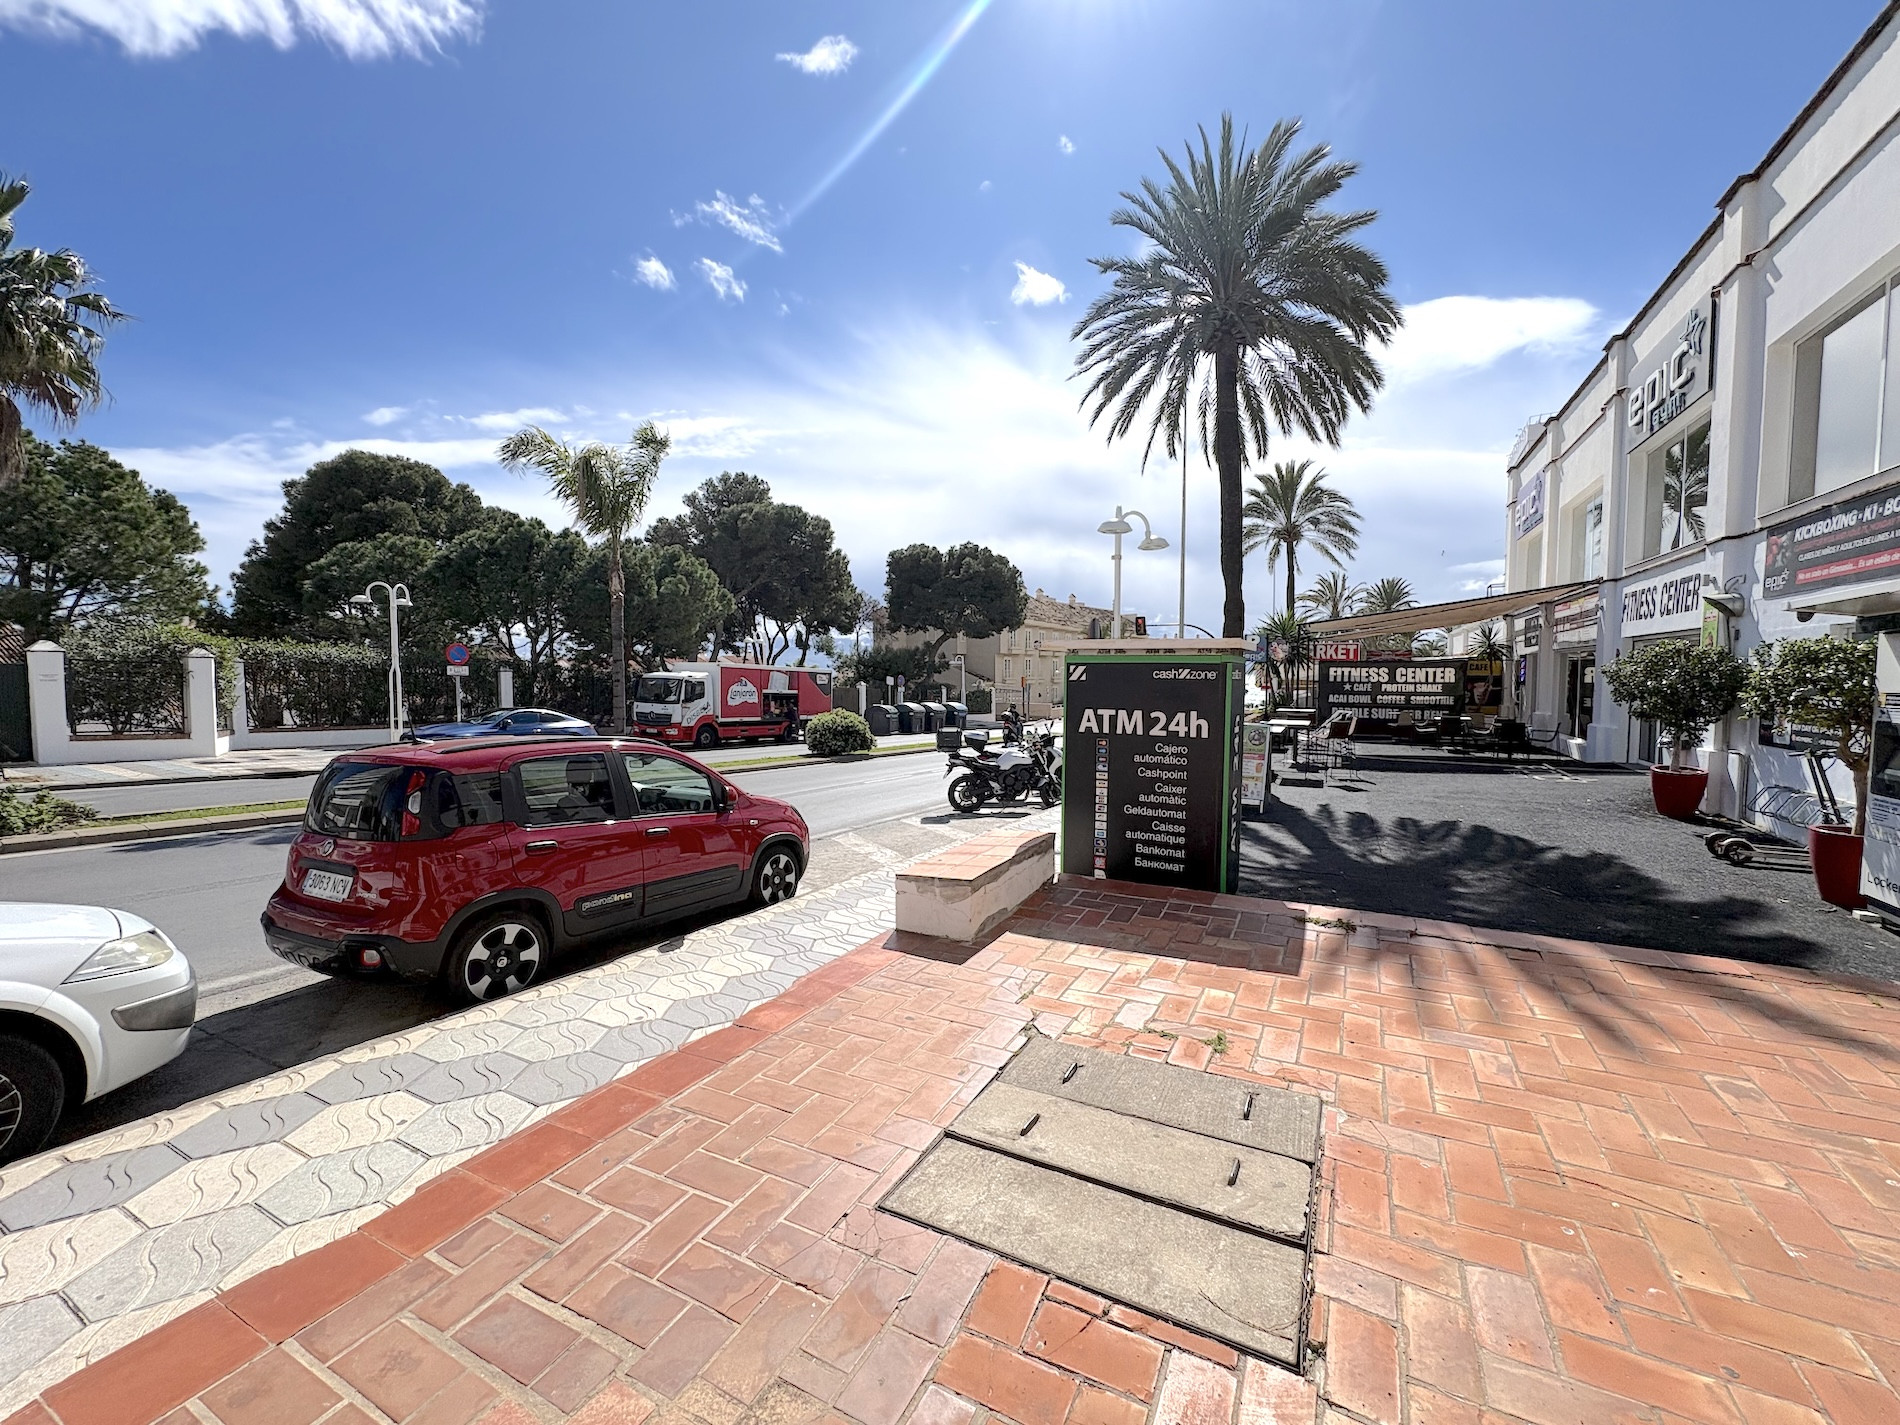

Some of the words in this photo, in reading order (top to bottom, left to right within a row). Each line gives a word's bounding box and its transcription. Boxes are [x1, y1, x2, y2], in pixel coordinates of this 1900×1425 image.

[1628, 341, 1690, 433] epic
[1621, 586, 1657, 623] FITNESS
[1660, 573, 1702, 617] CENTER
[1329, 667, 1389, 683] FITNESS
[1395, 667, 1456, 683] CENTER
[1381, 684, 1415, 693] PROTEIN
[1416, 683, 1443, 693] SHAKE
[1328, 694, 1348, 703] ACAI
[1350, 694, 1373, 704] BOWL
[1376, 695, 1406, 705] COFFEE
[1410, 695, 1455, 706] SMOOTHIE
[1078, 708, 1144, 736] ATM
[1148, 710, 1209, 739] 24h
[1154, 742, 1188, 756] Cajero
[1133, 752, 1188, 766] automático
[1137, 767, 1187, 781] Cashpoint
[1154, 782, 1187, 795] Caixer
[1138, 792, 1187, 805] automàtic
[1123, 805, 1187, 820] Geldautomat
[1151, 821, 1186, 833] Caisse
[1125, 829, 1186, 845] automatique
[1135, 843, 1185, 858] Bankomat
[1134, 857, 1185, 872] Банкомат
[309, 873, 331, 891] 3063
[581, 892, 633, 911] pandina
